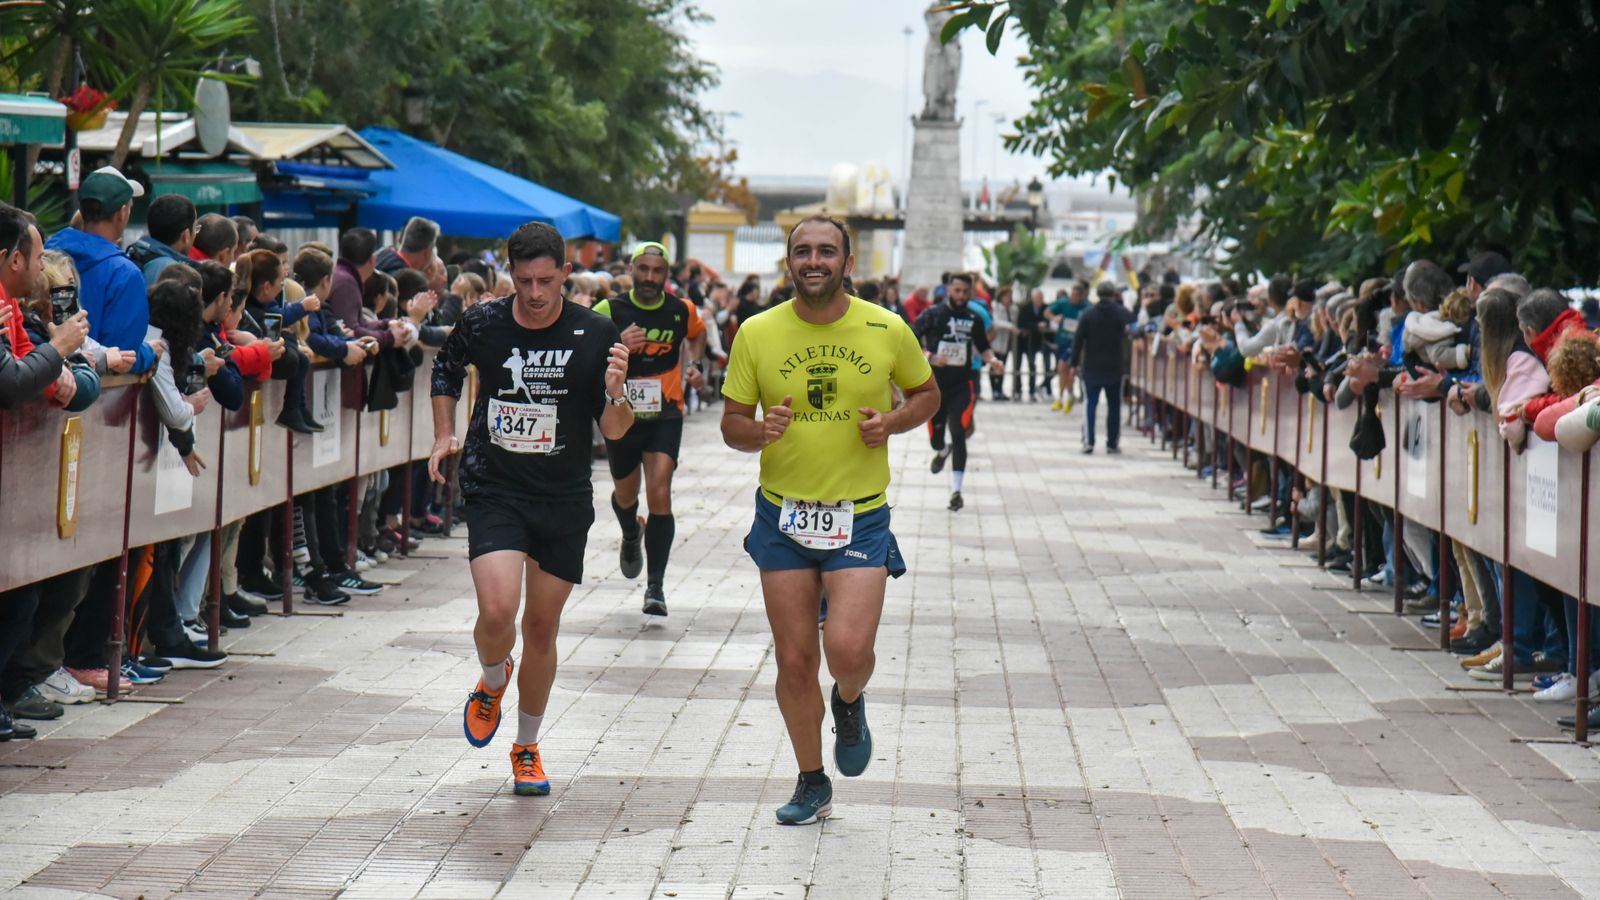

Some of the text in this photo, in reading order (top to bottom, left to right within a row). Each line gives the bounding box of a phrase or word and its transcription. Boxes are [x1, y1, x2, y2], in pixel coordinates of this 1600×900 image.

[526, 350, 573, 366] XIV
[778, 344, 872, 380] ATLETISMO
[498, 404, 518, 416] XIV
[793, 410, 851, 422] FACINAS
[502, 415, 538, 436] 347
[793, 501, 815, 510] XIV
[797, 510, 834, 532] 319
